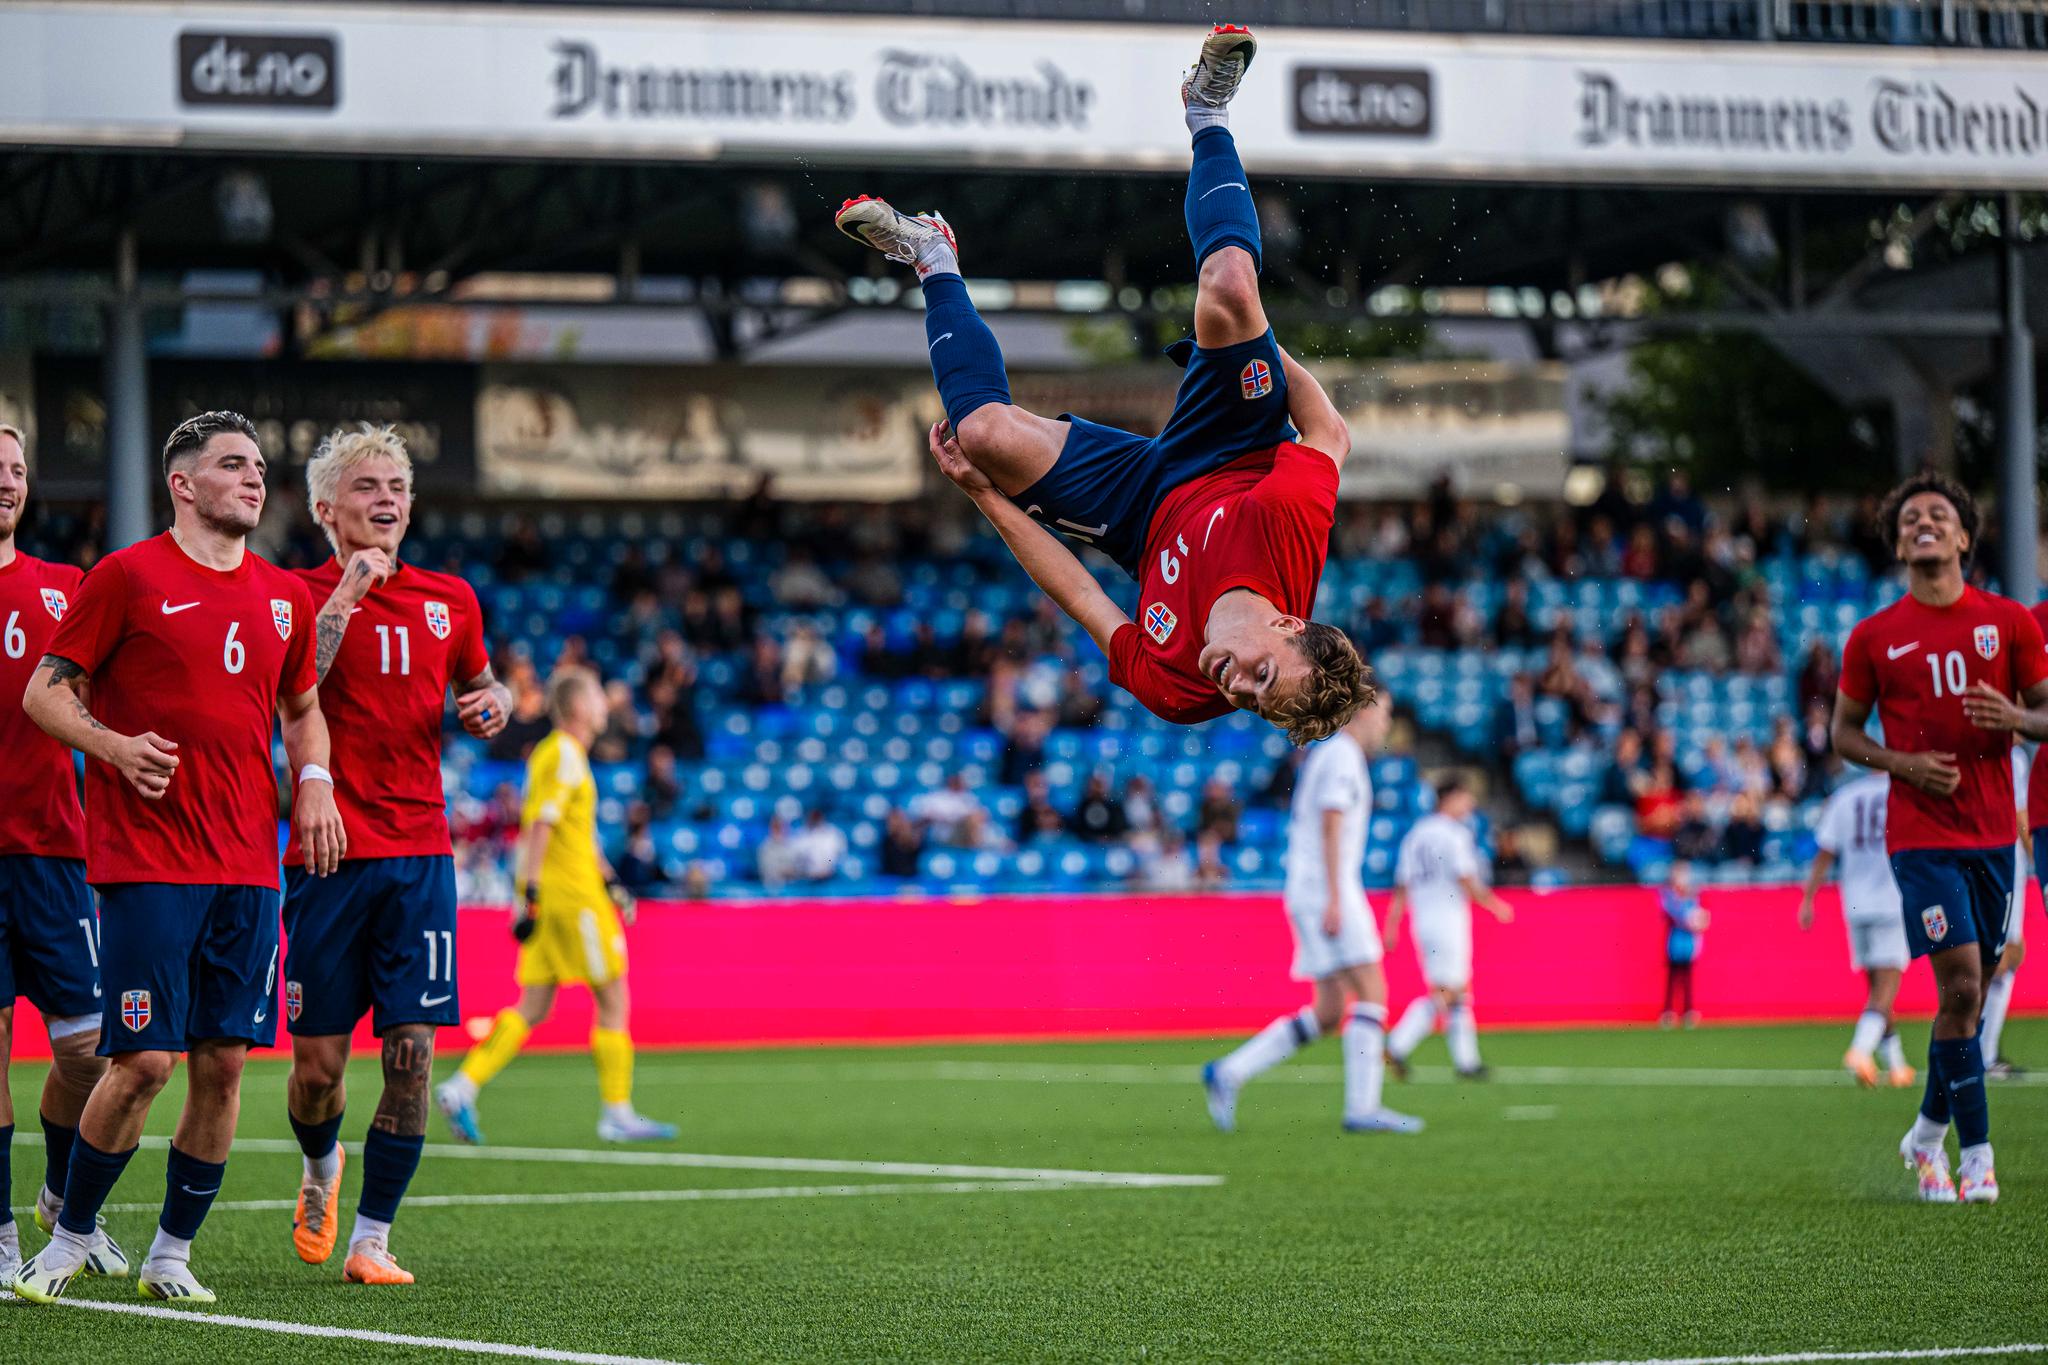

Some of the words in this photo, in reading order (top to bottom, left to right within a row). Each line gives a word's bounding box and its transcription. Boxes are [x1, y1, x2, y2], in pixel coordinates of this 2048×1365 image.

[191, 36, 328, 96] dt.no
[550, 38, 856, 124] Drammens
[875, 47, 1096, 131] Tidende
[1300, 70, 1427, 127] dt.no
[1575, 69, 1853, 152] Drammens
[1870, 76, 2048, 156] Tidend
[223, 621, 245, 674] 6
[375, 624, 410, 676] 11
[1926, 650, 1967, 698] 10
[78, 918, 101, 968] 1
[423, 930, 452, 982] 11
[265, 943, 279, 997] 6
